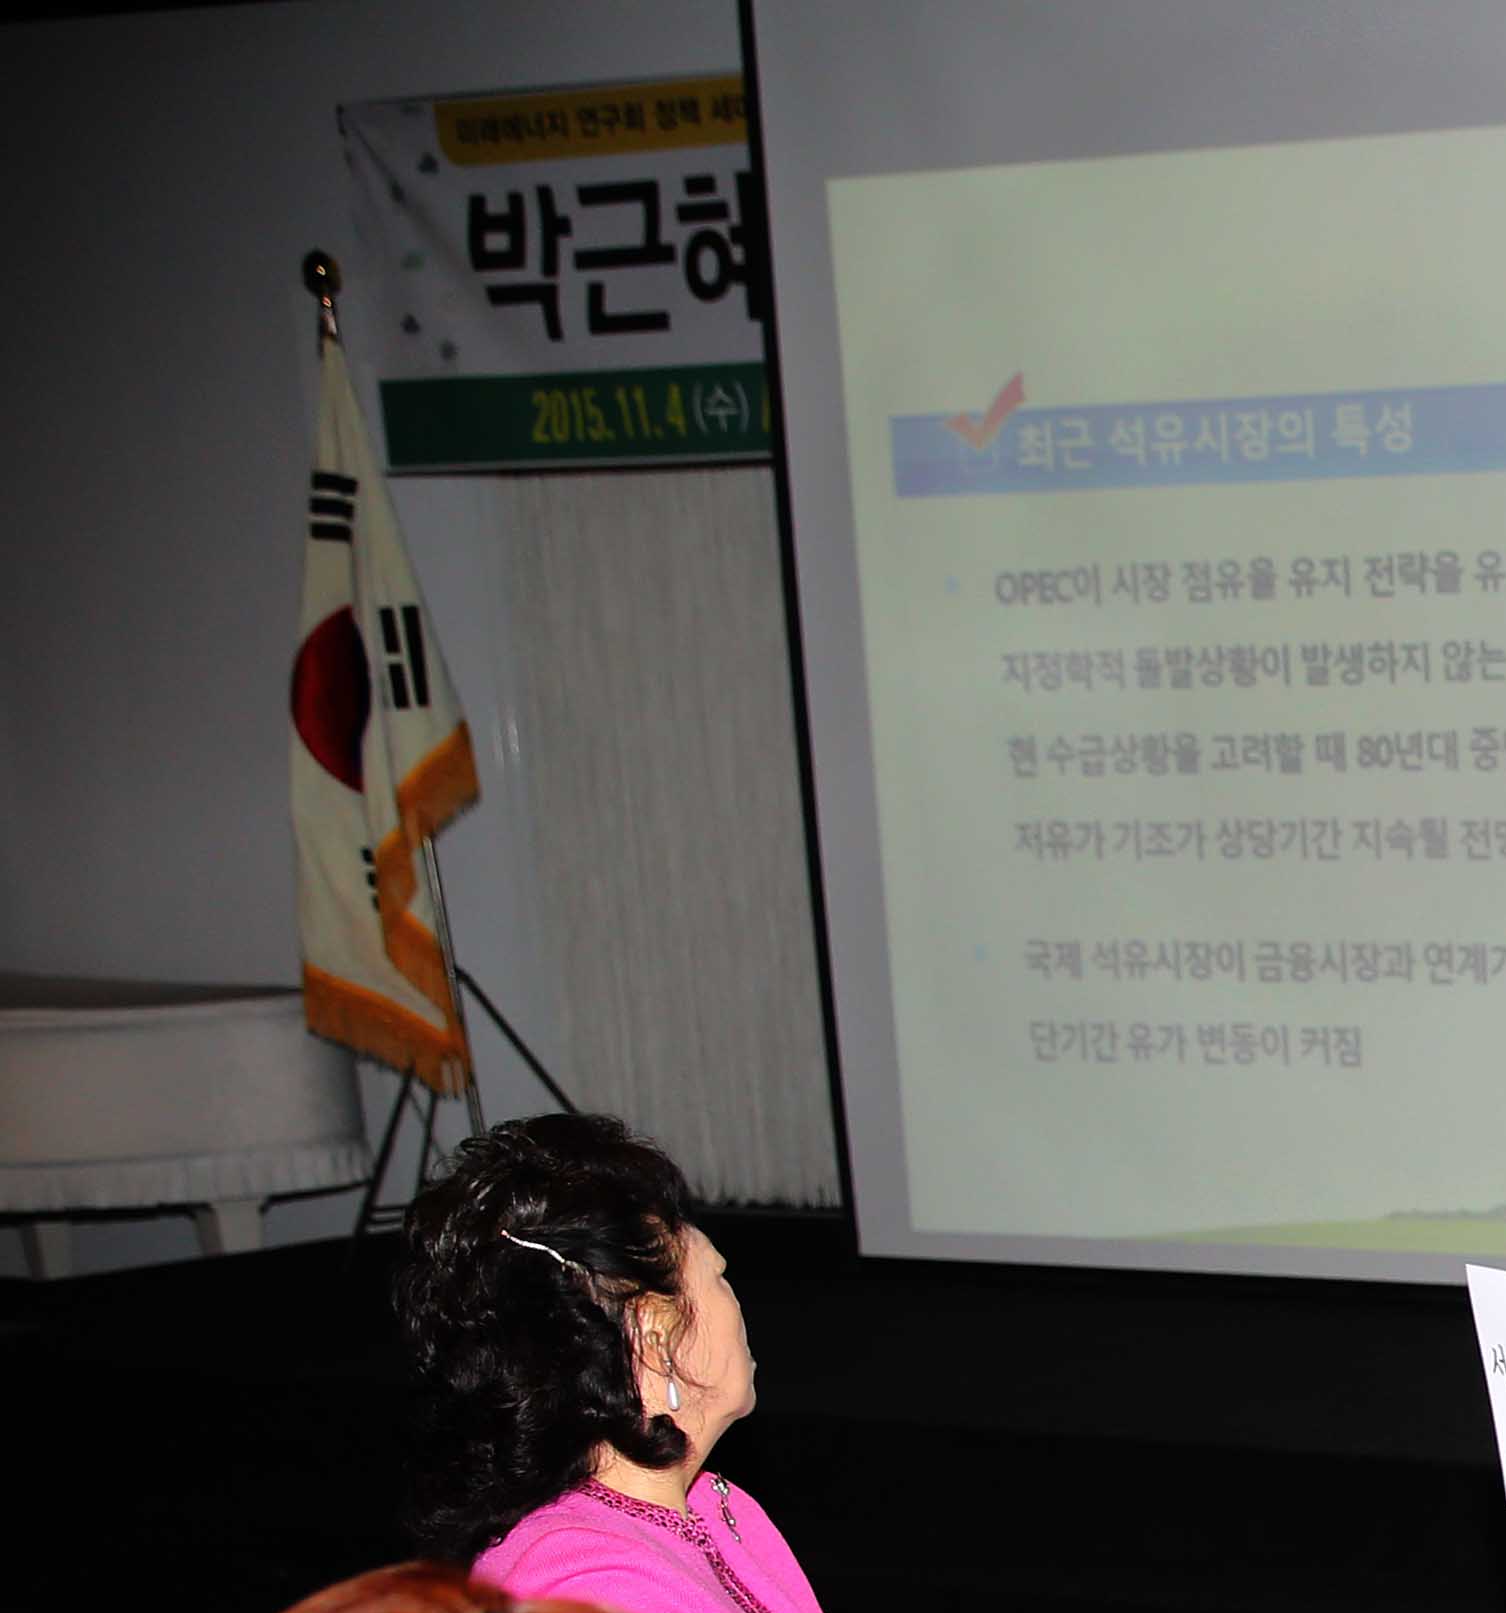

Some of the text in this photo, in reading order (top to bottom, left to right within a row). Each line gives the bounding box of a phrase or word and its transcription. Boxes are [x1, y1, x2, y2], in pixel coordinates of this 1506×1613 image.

[456, 109, 570, 146] 미래에너지
[577, 102, 647, 138] 연구회
[655, 97, 703, 133] 정책
[1016, 402, 1415, 473] 최근 석유시장의 특성
[994, 564, 1103, 606] OPEC이
[1112, 559, 1172, 604] 시장
[1289, 554, 1352, 599] 유지
[1363, 549, 1464, 598] 전략을
[1001, 650, 1127, 693] 지정학적
[1135, 643, 1292, 689] 돌발상황이
[1300, 640, 1431, 686] 발생하지
[1007, 734, 1038, 778] 현
[1046, 731, 1203, 777] 수급상황을
[1211, 731, 1306, 775] 고려할
[1314, 730, 1347, 773] 때
[1356, 729, 1459, 772] 80년대
[1014, 818, 1106, 861] 저유가
[1112, 818, 1206, 861] 기조가
[1215, 817, 1344, 861] 상당기간
[1024, 939, 1083, 981] 국제
[1091, 939, 1247, 982] 석유시장이
[1255, 939, 1417, 984] 금융시장과
[1029, 1020, 1363, 1069] 단기간 유가 변동이 커짐
